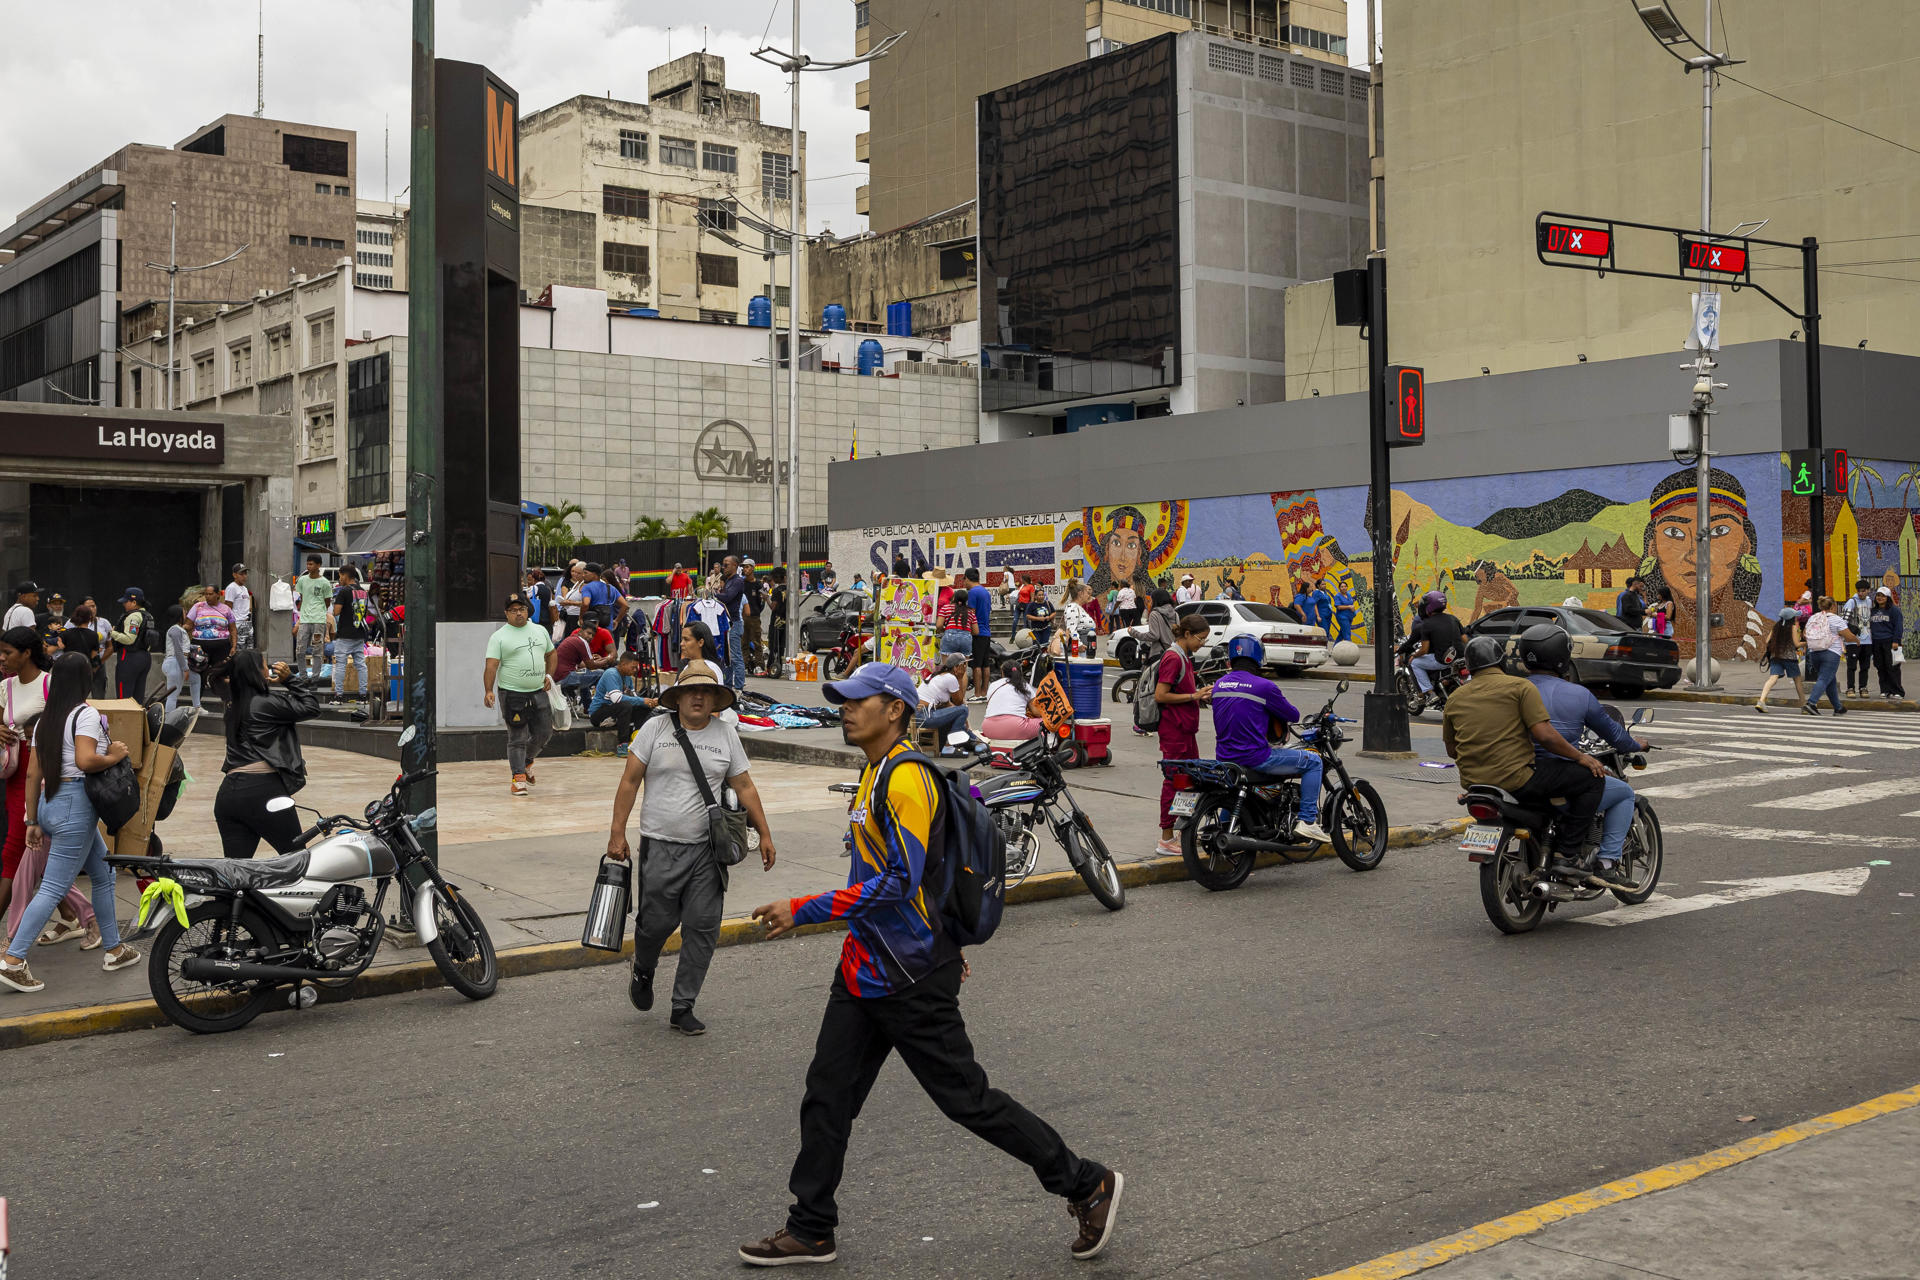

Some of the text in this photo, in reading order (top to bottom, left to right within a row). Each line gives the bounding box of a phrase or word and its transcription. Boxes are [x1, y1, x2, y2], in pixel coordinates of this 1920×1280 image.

[487, 85, 515, 187] M
[98, 426, 216, 453] La Hoyada
[302, 518, 330, 535] TATIANA
[862, 513, 1068, 538] REPUBLICA BOLIVARIANA DE VENEZUELA
